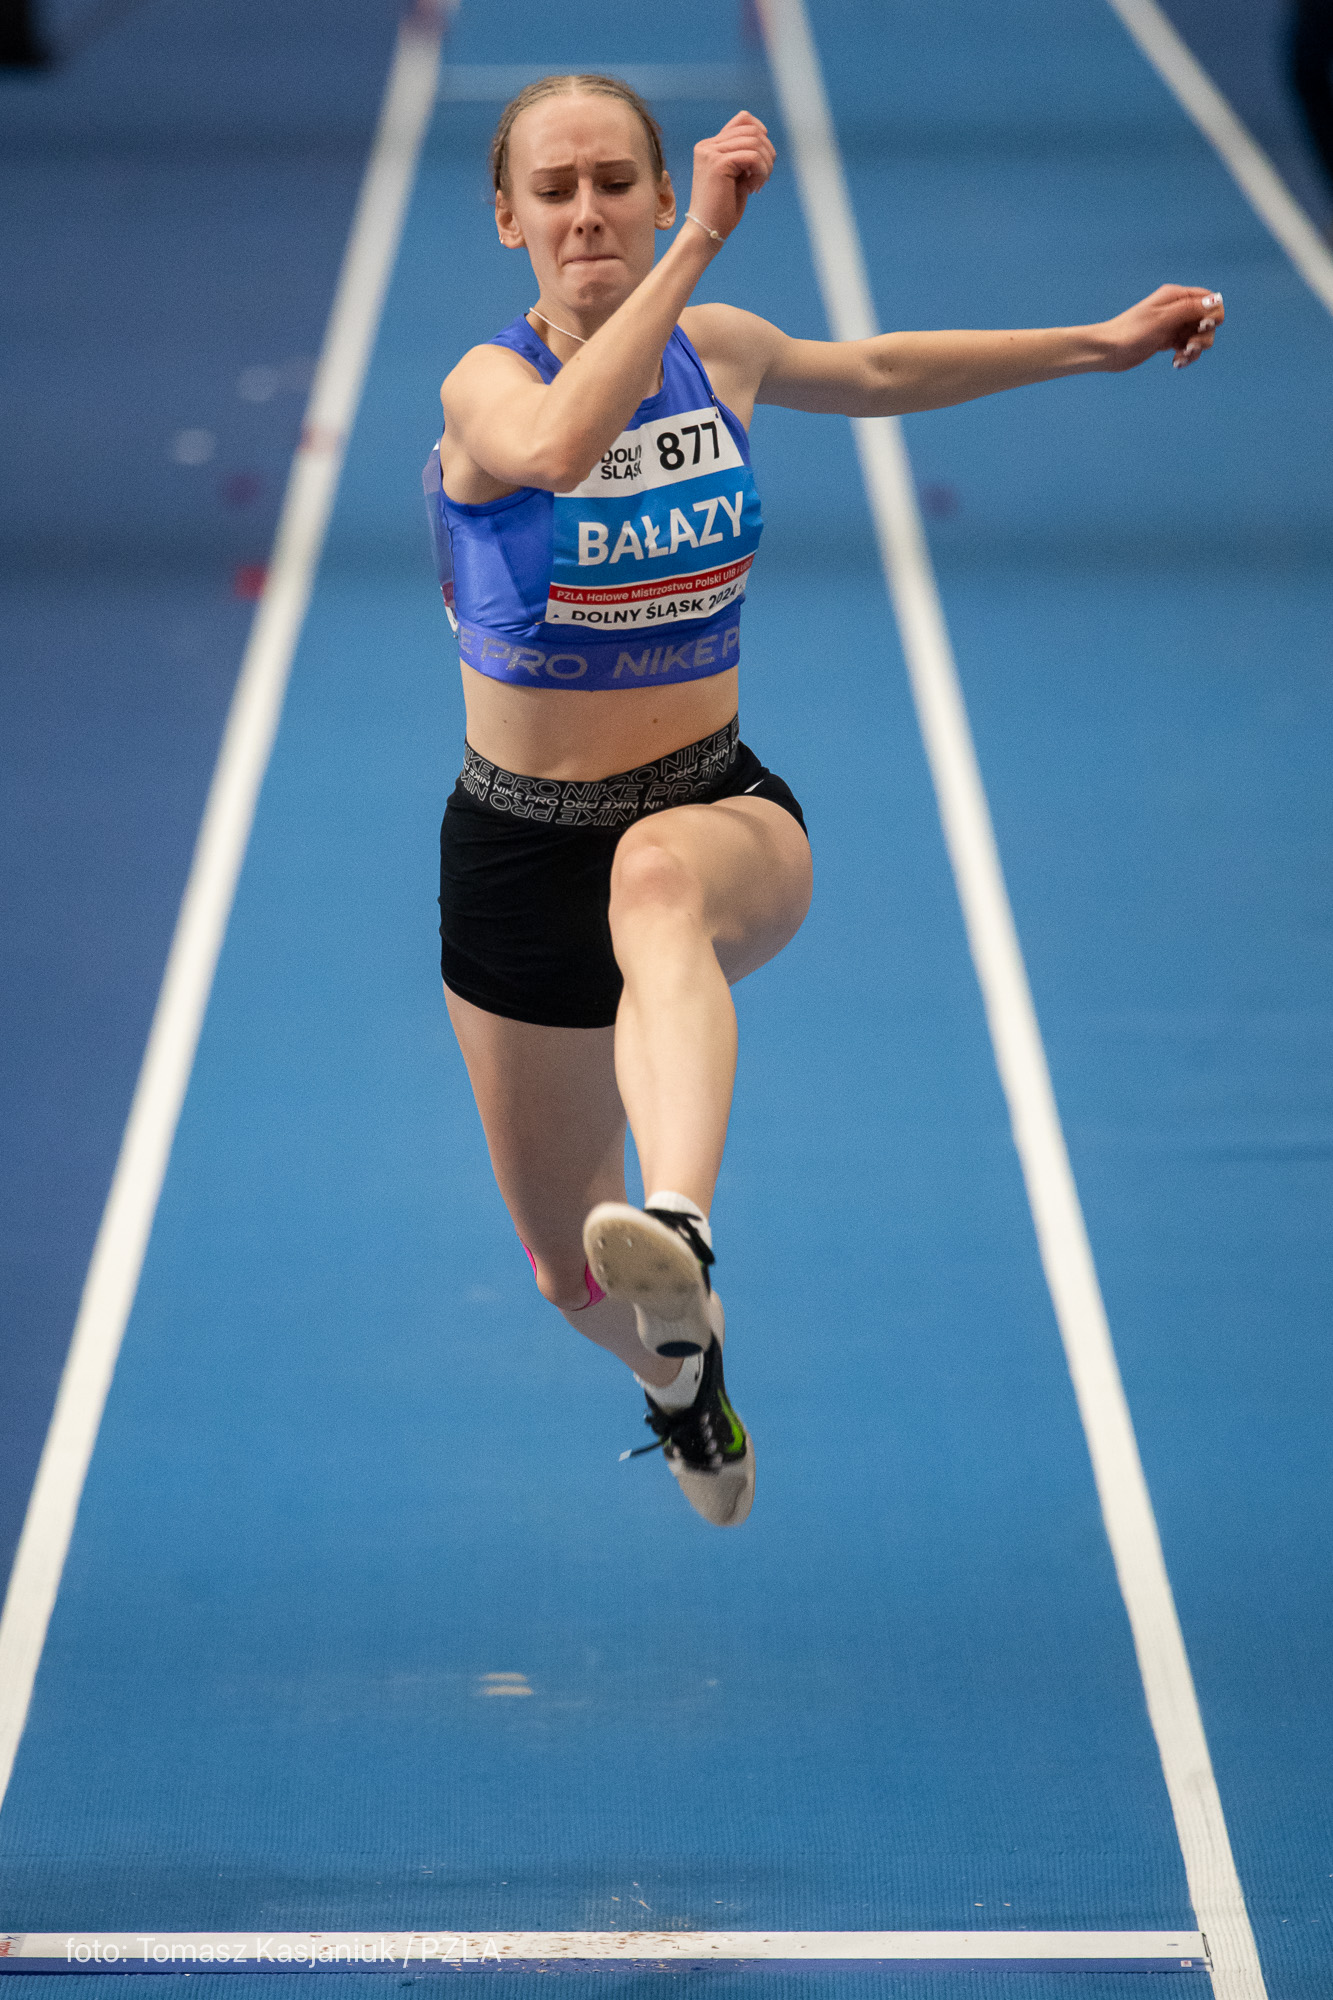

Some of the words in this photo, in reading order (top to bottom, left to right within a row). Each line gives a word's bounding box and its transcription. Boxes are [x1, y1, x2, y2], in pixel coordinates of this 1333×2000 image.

[656, 420, 720, 471] 877
[578, 490, 744, 566] BAŁAZY
[557, 590, 584, 602] PZLA
[586, 592, 629, 602] Halowe
[631, 582, 693, 599] Mistrzostwa
[695, 573, 722, 589] Polski
[571, 607, 642, 624] DOLNY
[645, 598, 705, 619] ŚLĄSK
[708, 583, 739, 610] 2024
[481, 636, 588, 680] PRO
[612, 634, 719, 679] NIKE
[464, 744, 495, 780] IKE
[494, 769, 561, 798] PRO
[561, 782, 644, 801] NIKE
[661, 727, 729, 778] NIKE
[489, 792, 556, 823] PRO
[492, 783, 524, 800] NIKE
[525, 795, 559, 807] PRO
